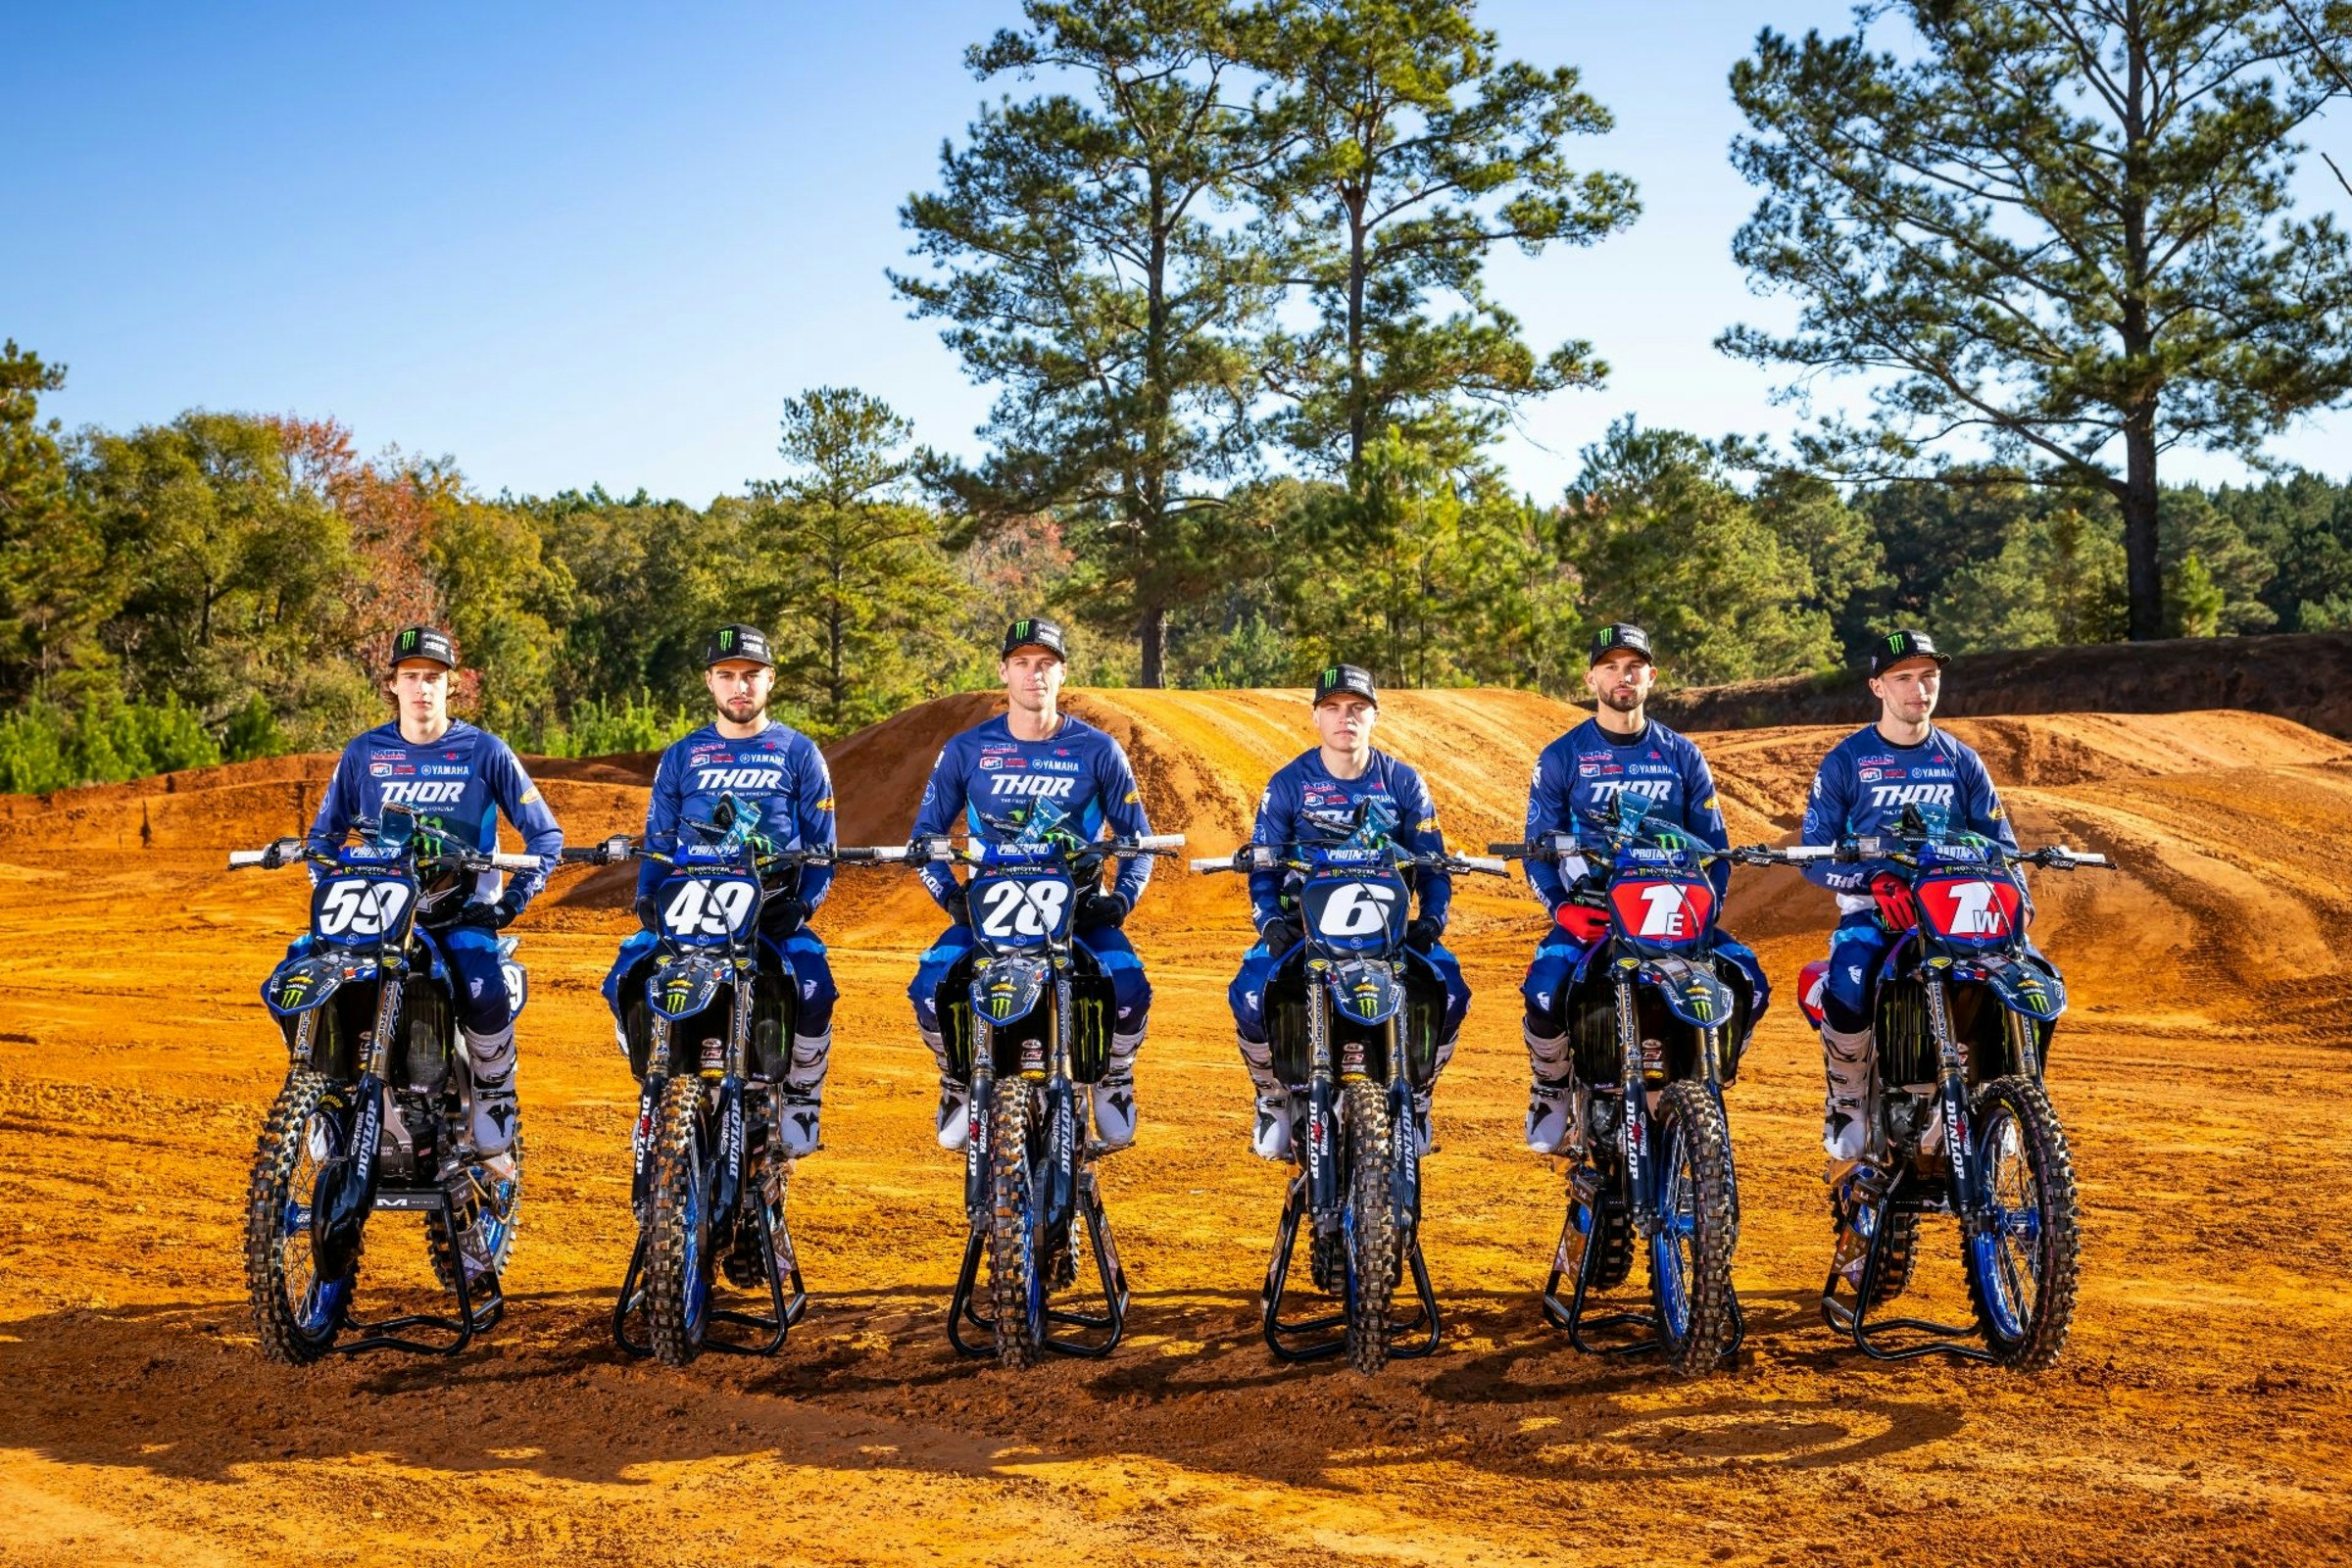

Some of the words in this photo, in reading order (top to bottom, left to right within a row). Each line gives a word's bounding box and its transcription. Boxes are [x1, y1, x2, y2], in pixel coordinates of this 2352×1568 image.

[380, 781, 466, 803] THOR
[431, 765, 469, 775] YAMAHA
[697, 769, 783, 790] THOR
[990, 774, 1076, 798] THOR
[1042, 760, 1079, 772] YAMAHA
[1590, 780, 1673, 803] THOR
[1640, 764, 1674, 774] YAMAHA
[1871, 784, 1955, 807] THOR
[318, 879, 410, 935] 59
[664, 879, 755, 935] 49
[916, 866, 944, 899] THOR
[1826, 871, 1864, 889] THOR
[982, 880, 1069, 937] 28
[1319, 883, 1396, 935] 6
[502, 964, 523, 1011] 9
[358, 1100, 377, 1180] DUNLOP
[635, 1095, 651, 1175] DULOP
[729, 1098, 742, 1180] DUNLOP
[968, 1099, 979, 1177] DULOP
[1061, 1096, 1071, 1176] DUNLOP
[1308, 1100, 1319, 1179] DUNLOP
[1401, 1104, 1416, 1186] DUNLOP
[1625, 1100, 1639, 1180] DUNLOP
[1945, 1100, 1966, 1180] DUNLOP
